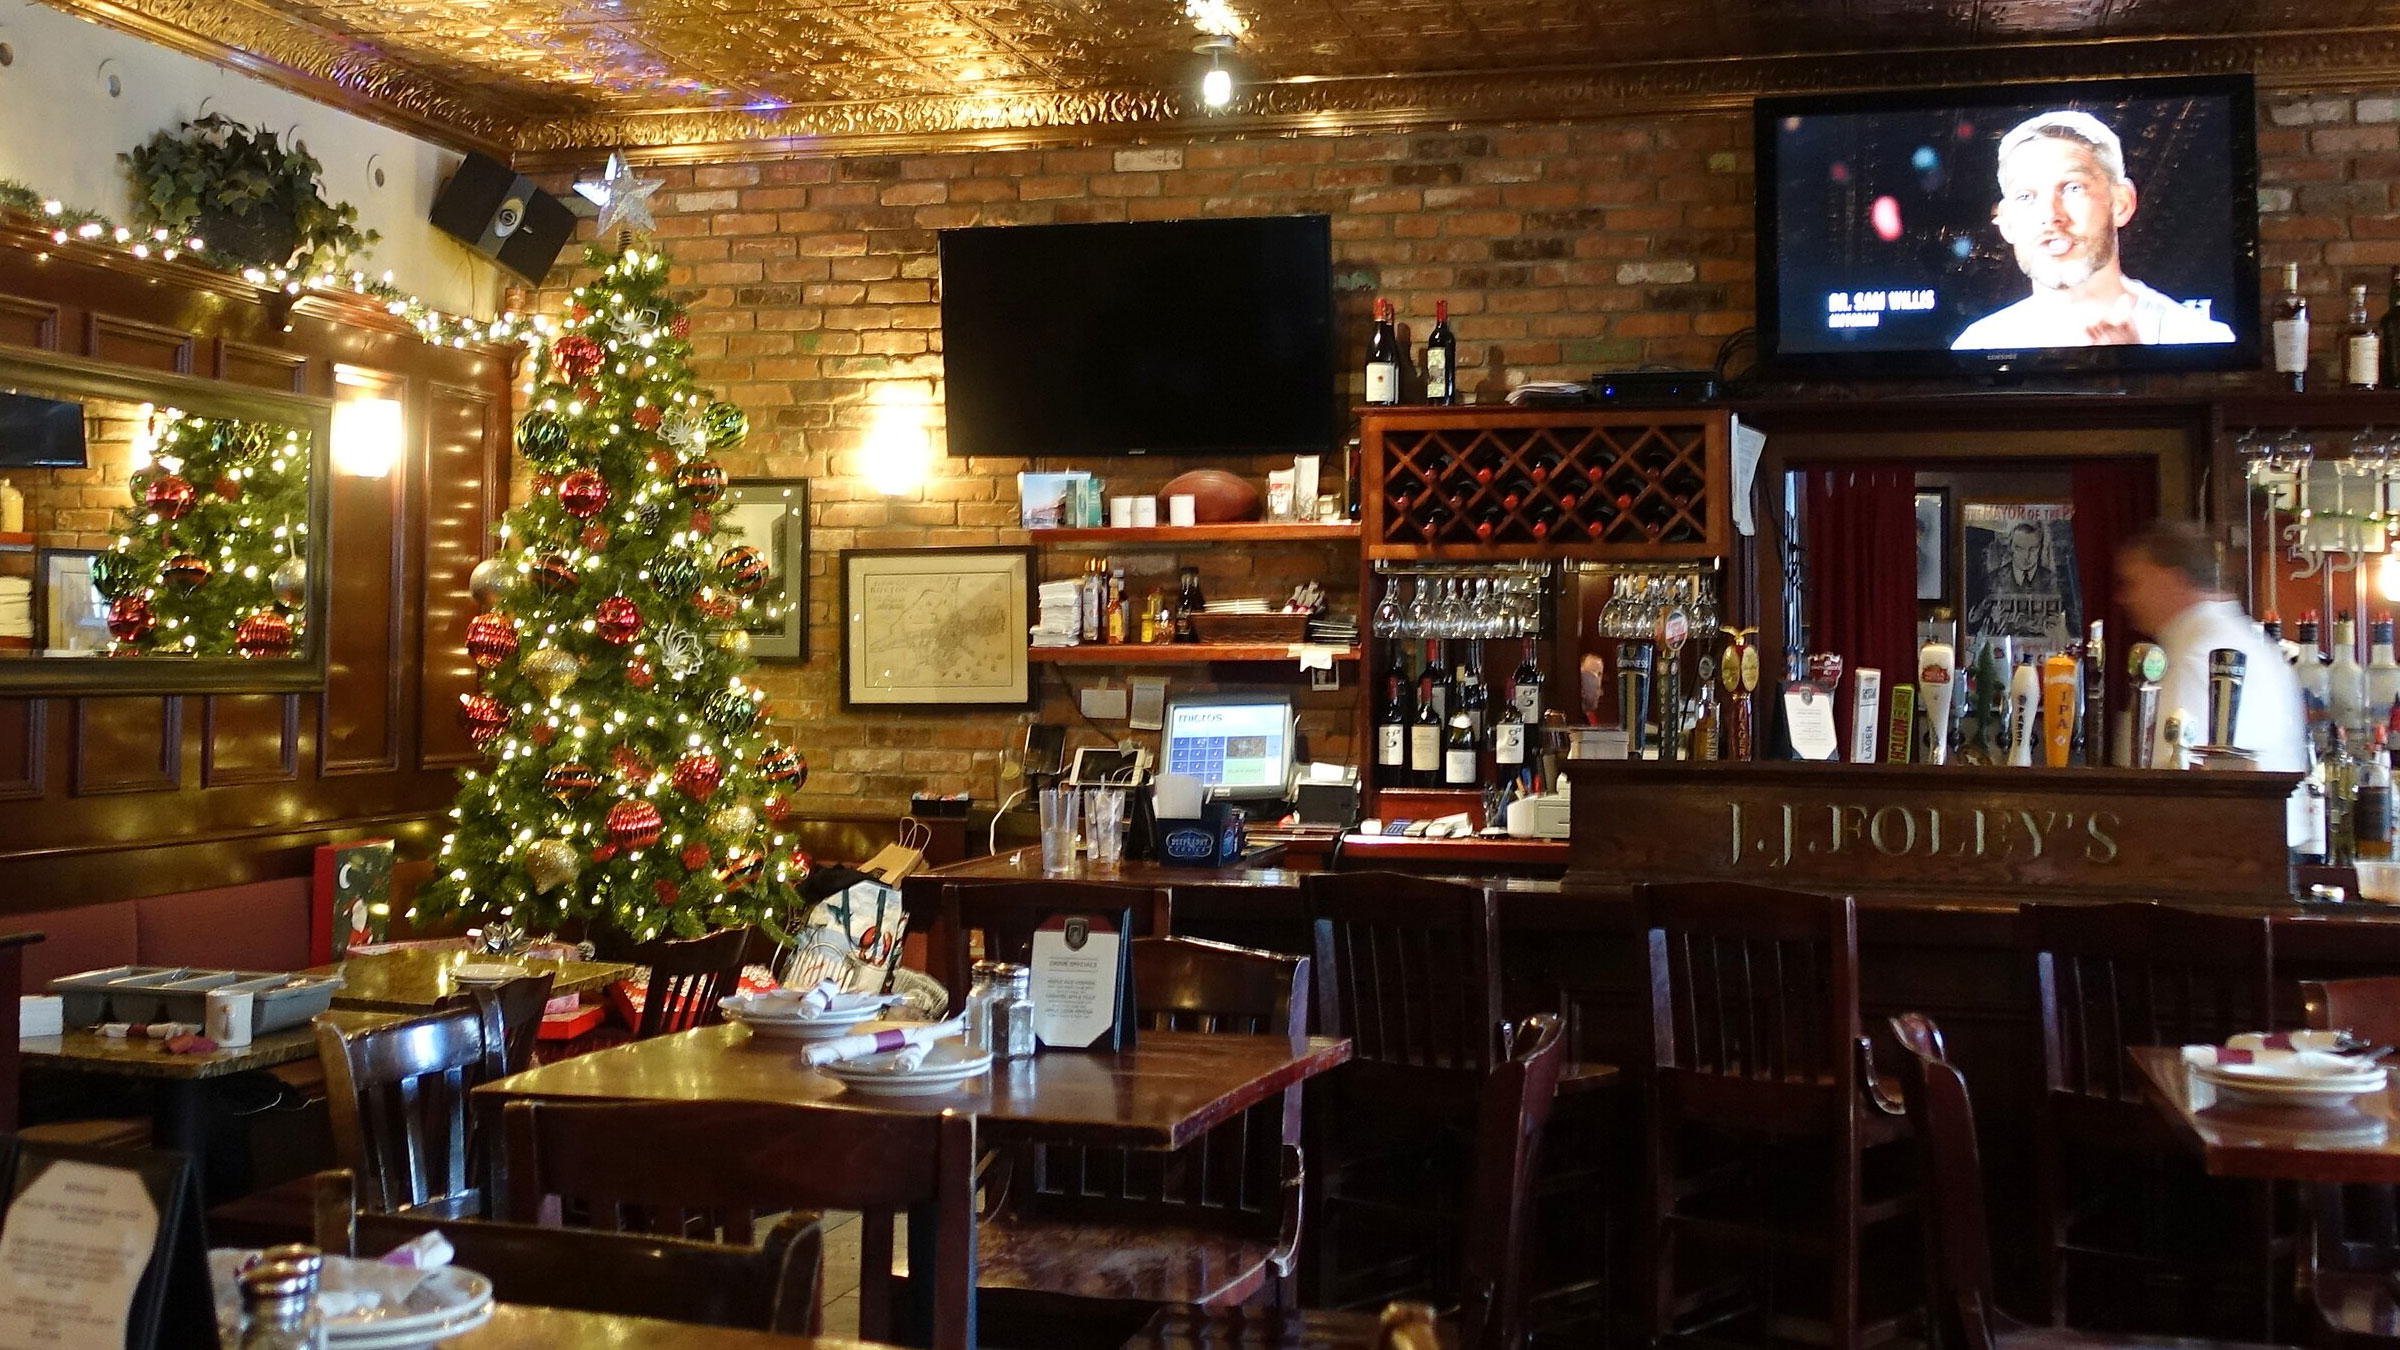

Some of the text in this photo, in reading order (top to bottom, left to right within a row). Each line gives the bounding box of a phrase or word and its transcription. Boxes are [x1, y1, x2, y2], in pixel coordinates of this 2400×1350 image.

[1854, 291, 1886, 311] SAM
[1888, 289, 1935, 310] WILLIS
[1983, 504, 2027, 520] MAYOR
[2028, 509, 2041, 520] OF
[1179, 713, 1223, 723] micros
[2056, 691, 2069, 730] IPA
[2017, 706, 2025, 746] PABST
[1864, 725, 1873, 760] LAGER
